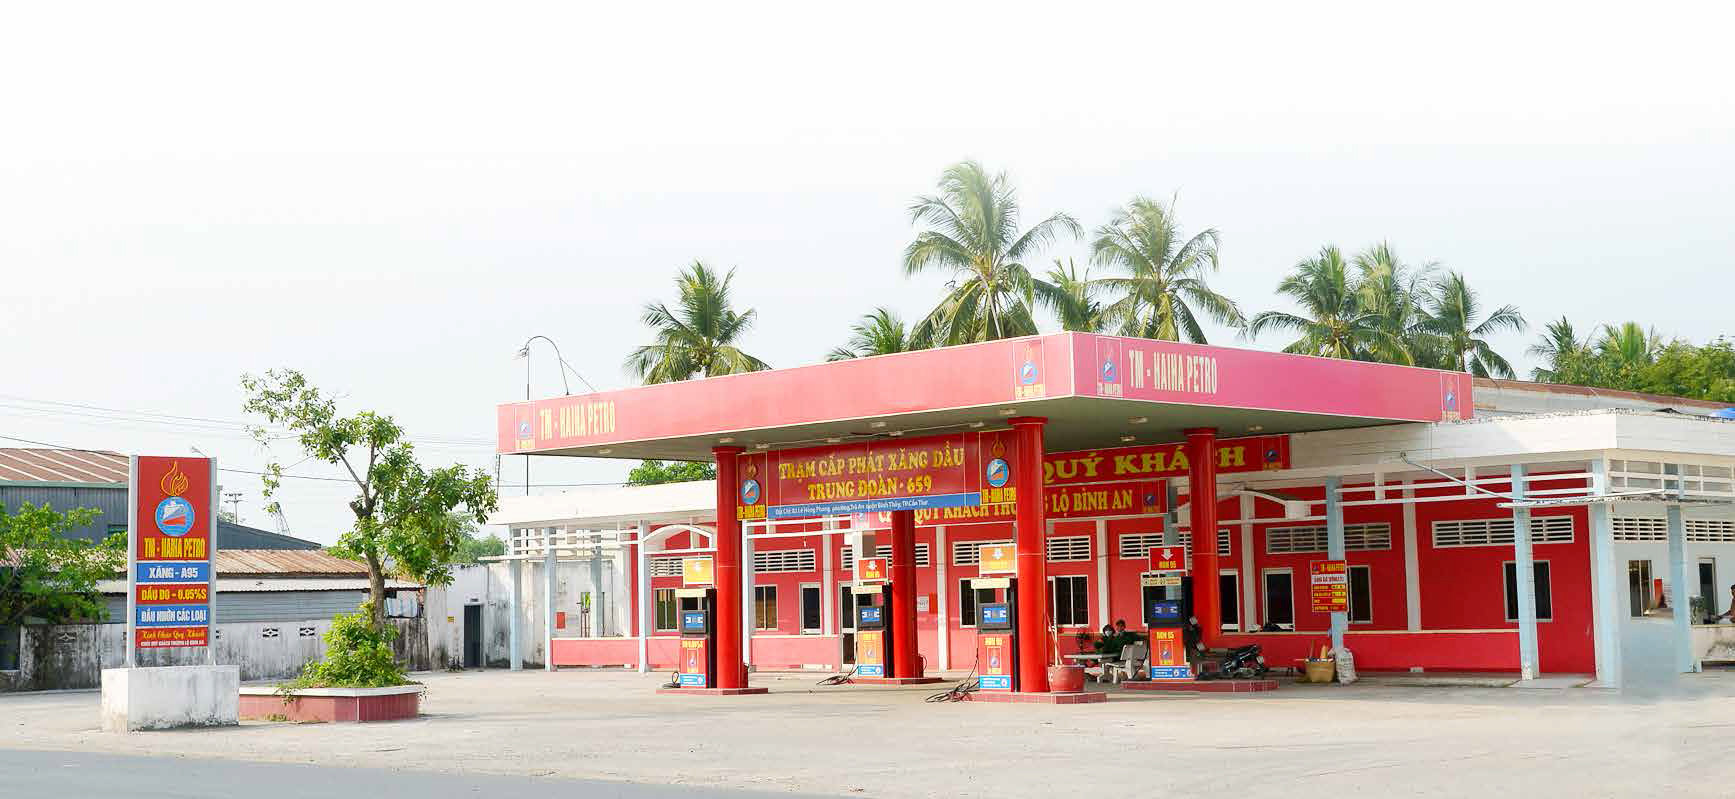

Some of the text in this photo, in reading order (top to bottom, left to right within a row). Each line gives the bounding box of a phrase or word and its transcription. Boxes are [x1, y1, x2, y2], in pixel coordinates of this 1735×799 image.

[1129, 350, 1144, 389] TM
[1153, 352, 1185, 391] HAIHA
[1186, 353, 1218, 395] PETRO
[539, 407, 553, 440] TM
[560, 402, 586, 438] HAIHA
[587, 399, 616, 435] PETRO
[1114, 445, 1246, 476] KHÁH
[808, 481, 855, 501] TRUNG
[906, 474, 932, 494] 659
[1112, 489, 1133, 508] AN
[144, 537, 156, 558] TM
[161, 537, 182, 558] HAIHA
[183, 537, 206, 558] PETRO
[180, 567, 199, 578] A95
